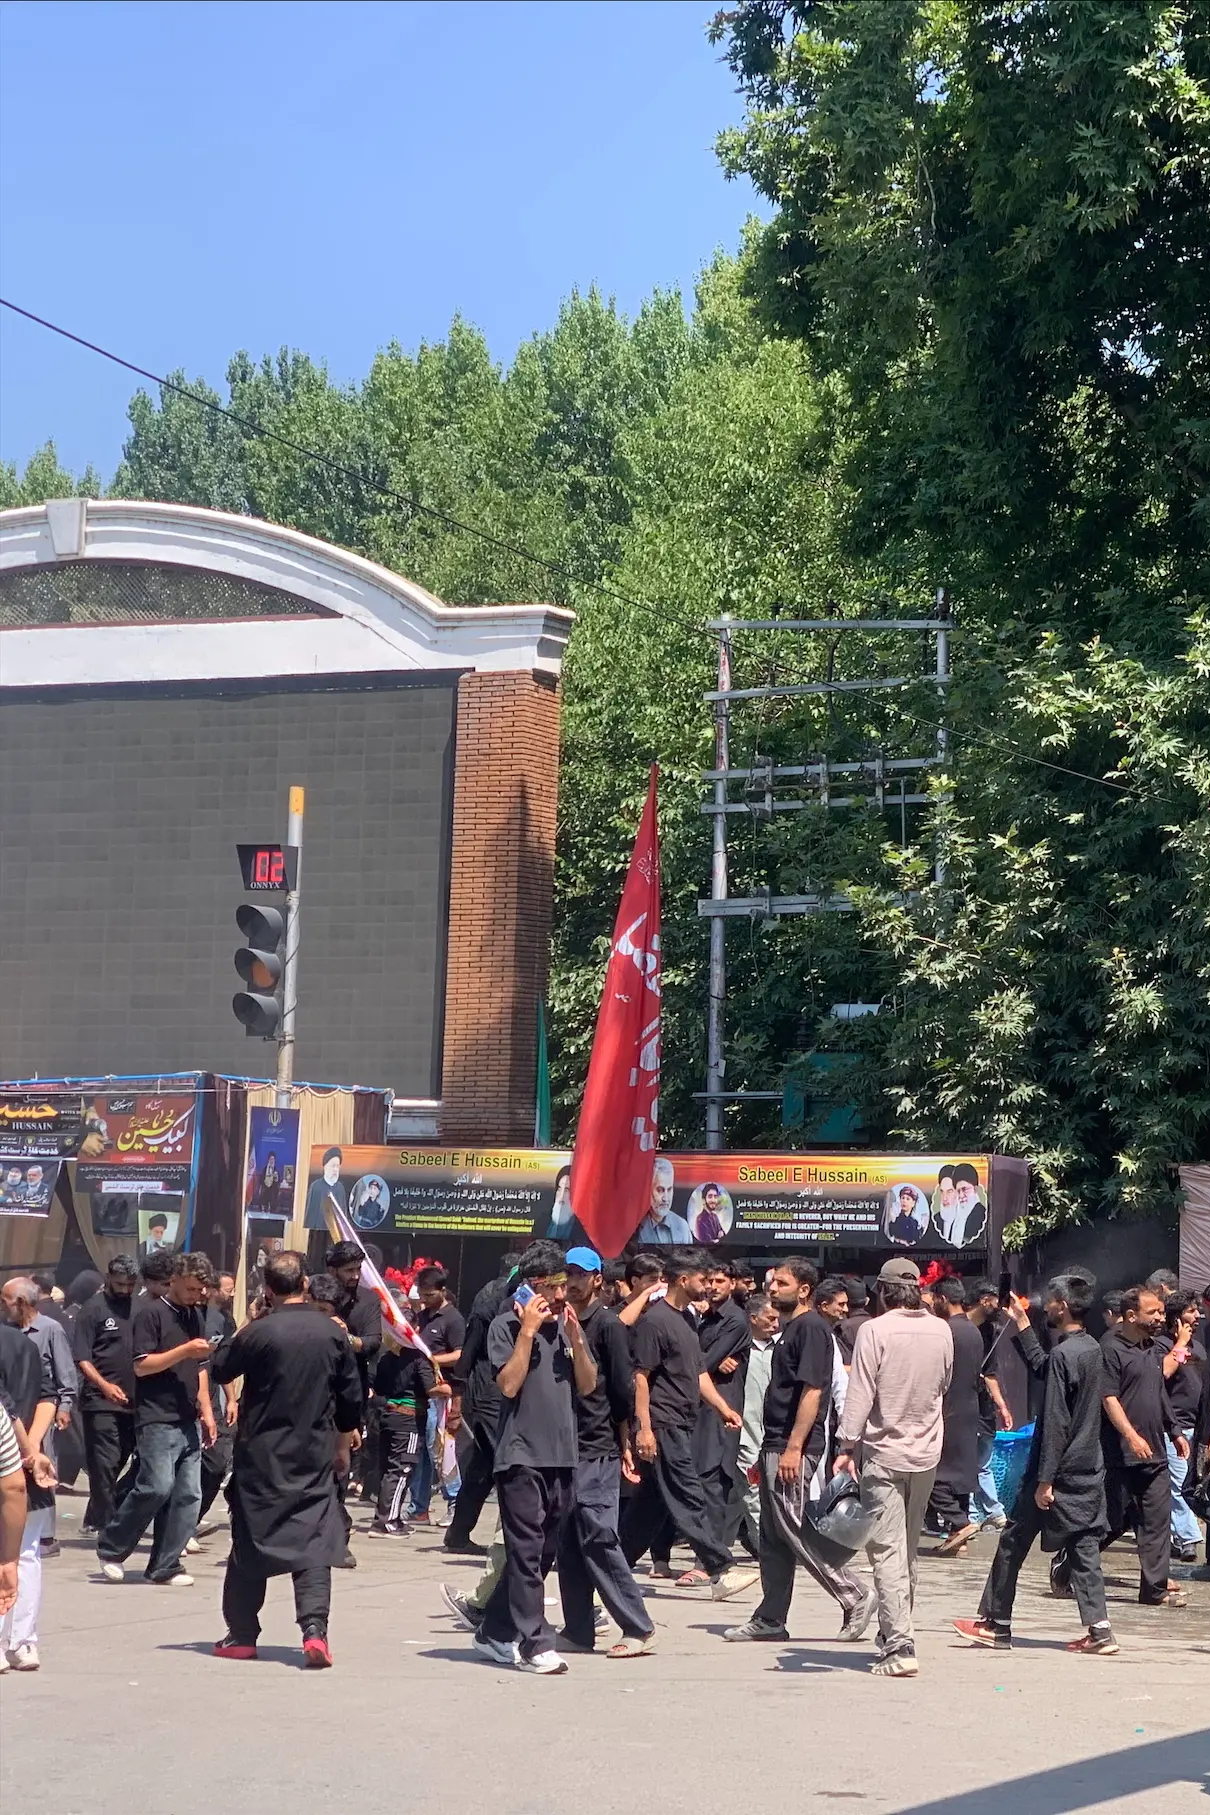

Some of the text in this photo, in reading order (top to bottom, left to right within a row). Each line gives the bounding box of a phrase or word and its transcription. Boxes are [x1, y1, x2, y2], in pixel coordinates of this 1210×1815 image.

[256, 851, 284, 882] 02
[12, 1122, 53, 1130] HUSSAIN
[399, 1151, 540, 1170] Sabeel E Hussain (AS)
[739, 1167, 887, 1185] Sabeel E Hussain (AS)
